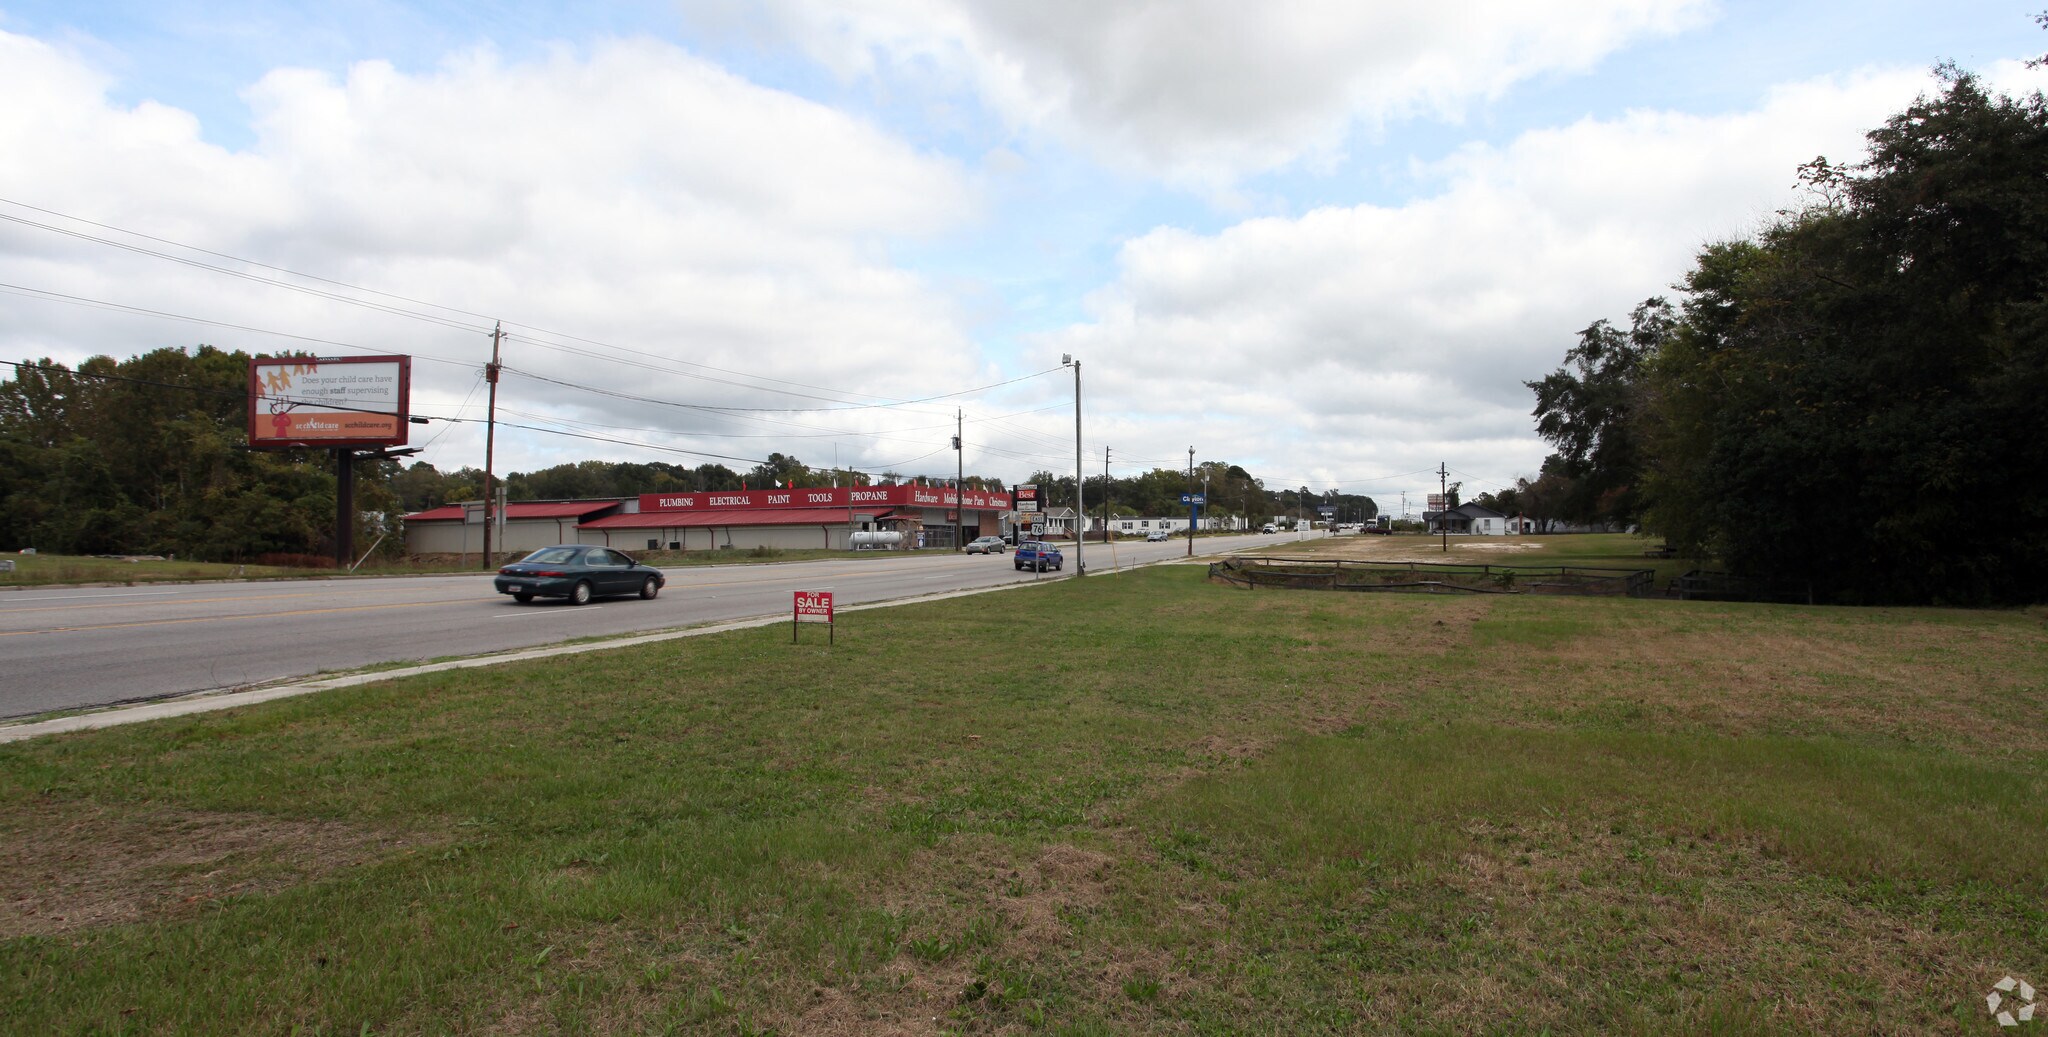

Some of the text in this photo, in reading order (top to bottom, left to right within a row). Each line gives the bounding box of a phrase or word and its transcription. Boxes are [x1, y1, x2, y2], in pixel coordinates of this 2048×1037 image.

[321, 378, 337, 386] your
[338, 376, 356, 384] child
[375, 375, 392, 383] have
[302, 387, 328, 396] enough
[348, 386, 389, 396] supervising
[768, 495, 790, 504] PAINT
[808, 493, 833, 502] TOOLS
[851, 491, 887, 501] PROPANE
[915, 491, 938, 503] Hardware
[1018, 491, 1034, 499] Best
[660, 498, 693, 507] PLUMBING
[709, 496, 751, 506] ELECTRICAL
[974, 495, 984, 506] Parts
[989, 496, 1007, 507] Christmas
[1033, 525, 1042, 533] 76
[797, 597, 829, 608] SALE
